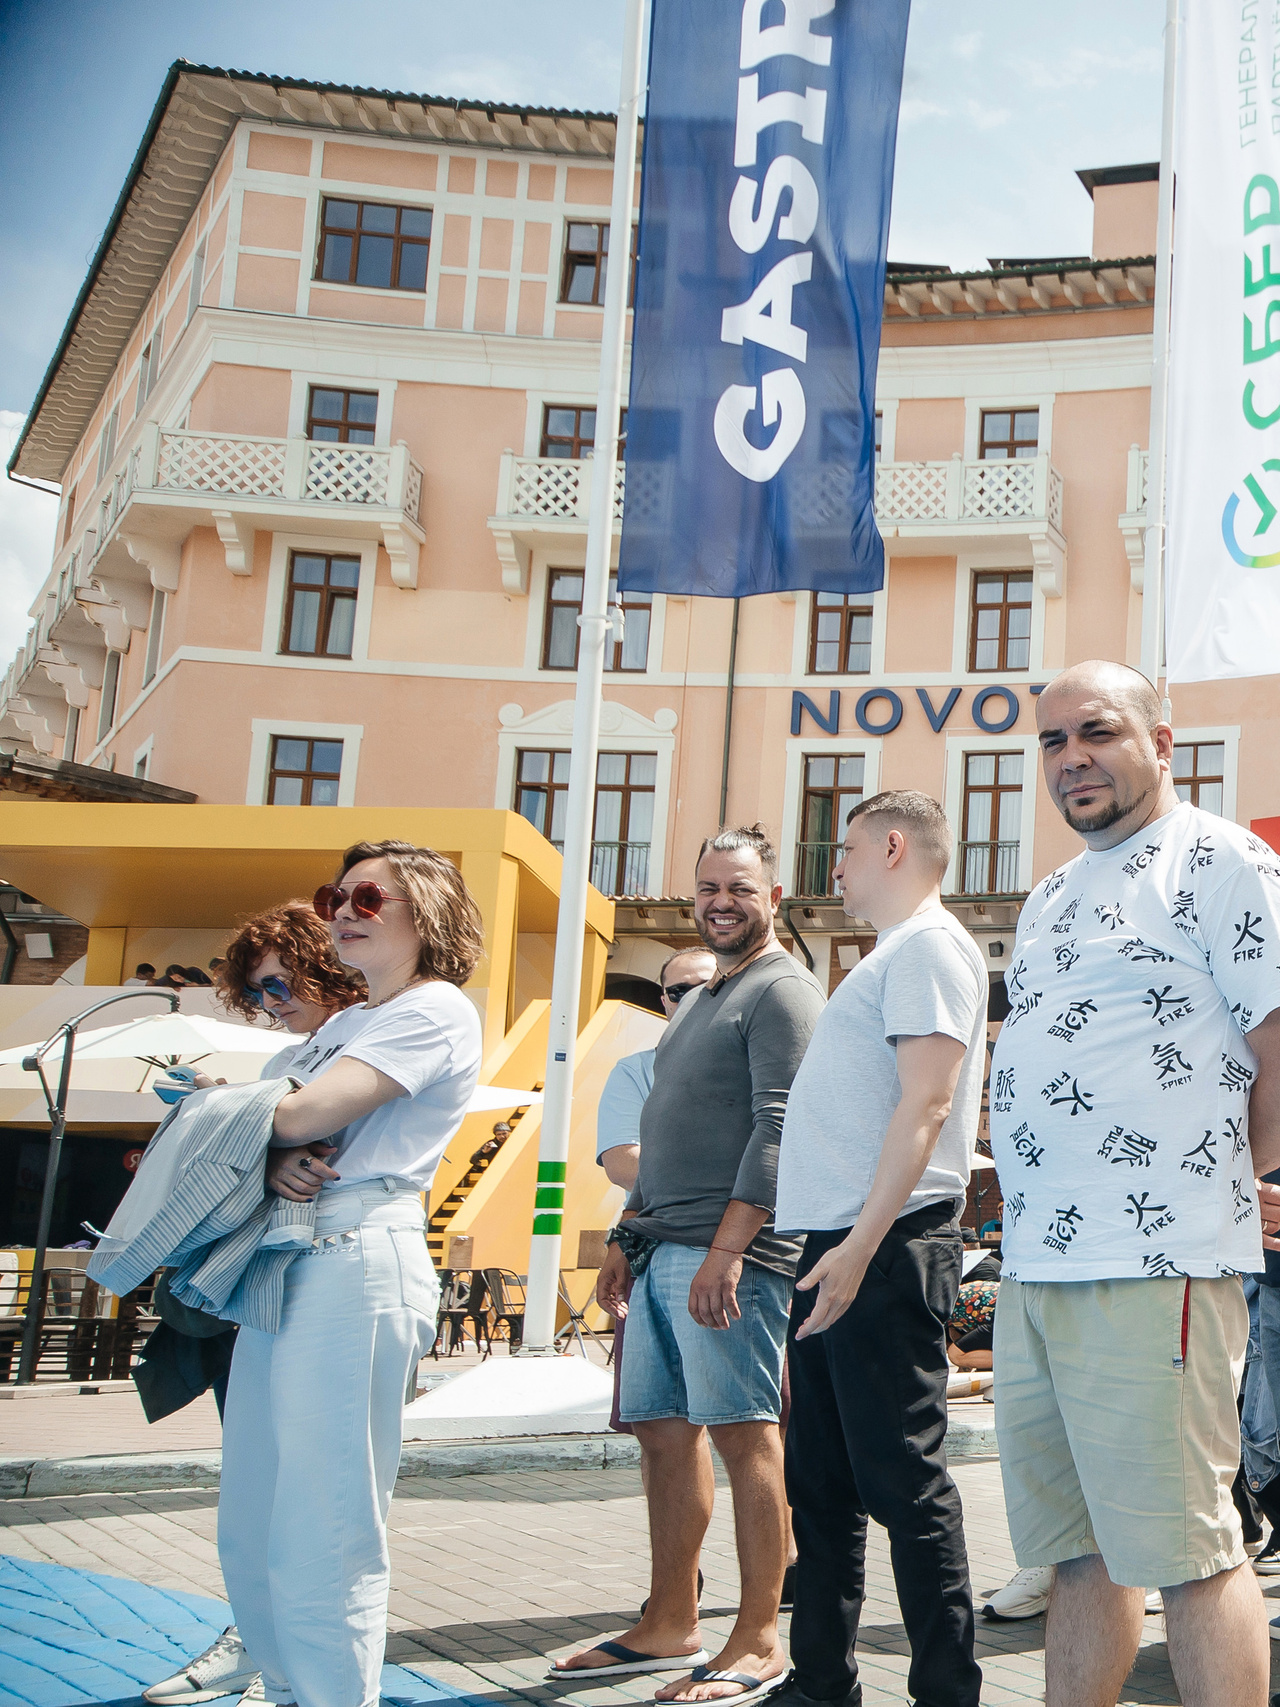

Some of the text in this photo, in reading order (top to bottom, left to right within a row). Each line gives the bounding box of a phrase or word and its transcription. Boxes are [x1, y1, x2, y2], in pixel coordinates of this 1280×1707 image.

[1189, 836, 1215, 866] 火
[1046, 877, 1065, 898] FIRE
[1050, 923, 1072, 934] PULSE
[1231, 910, 1265, 951] 火
[1233, 947, 1264, 965] FIRE
[1141, 985, 1189, 1019] 火
[1158, 1002, 1195, 1027] FIRE
[1047, 1025, 1075, 1043] GOAL
[1150, 1042, 1194, 1081] 気
[1041, 1071, 1071, 1100] FIRE
[1160, 1075, 1193, 1091] SPIRIT
[993, 1102, 1012, 1112] PULSE
[1050, 1077, 1095, 1116] 火
[1009, 1121, 1029, 1143] GOAL
[1097, 1124, 1125, 1159] PULSE
[1180, 1160, 1215, 1178] FIRE
[1123, 1192, 1168, 1229] 火
[1234, 1207, 1255, 1226] SPIRIT
[1142, 1211, 1176, 1237] FIRE
[1042, 1235, 1067, 1255] GOAL
